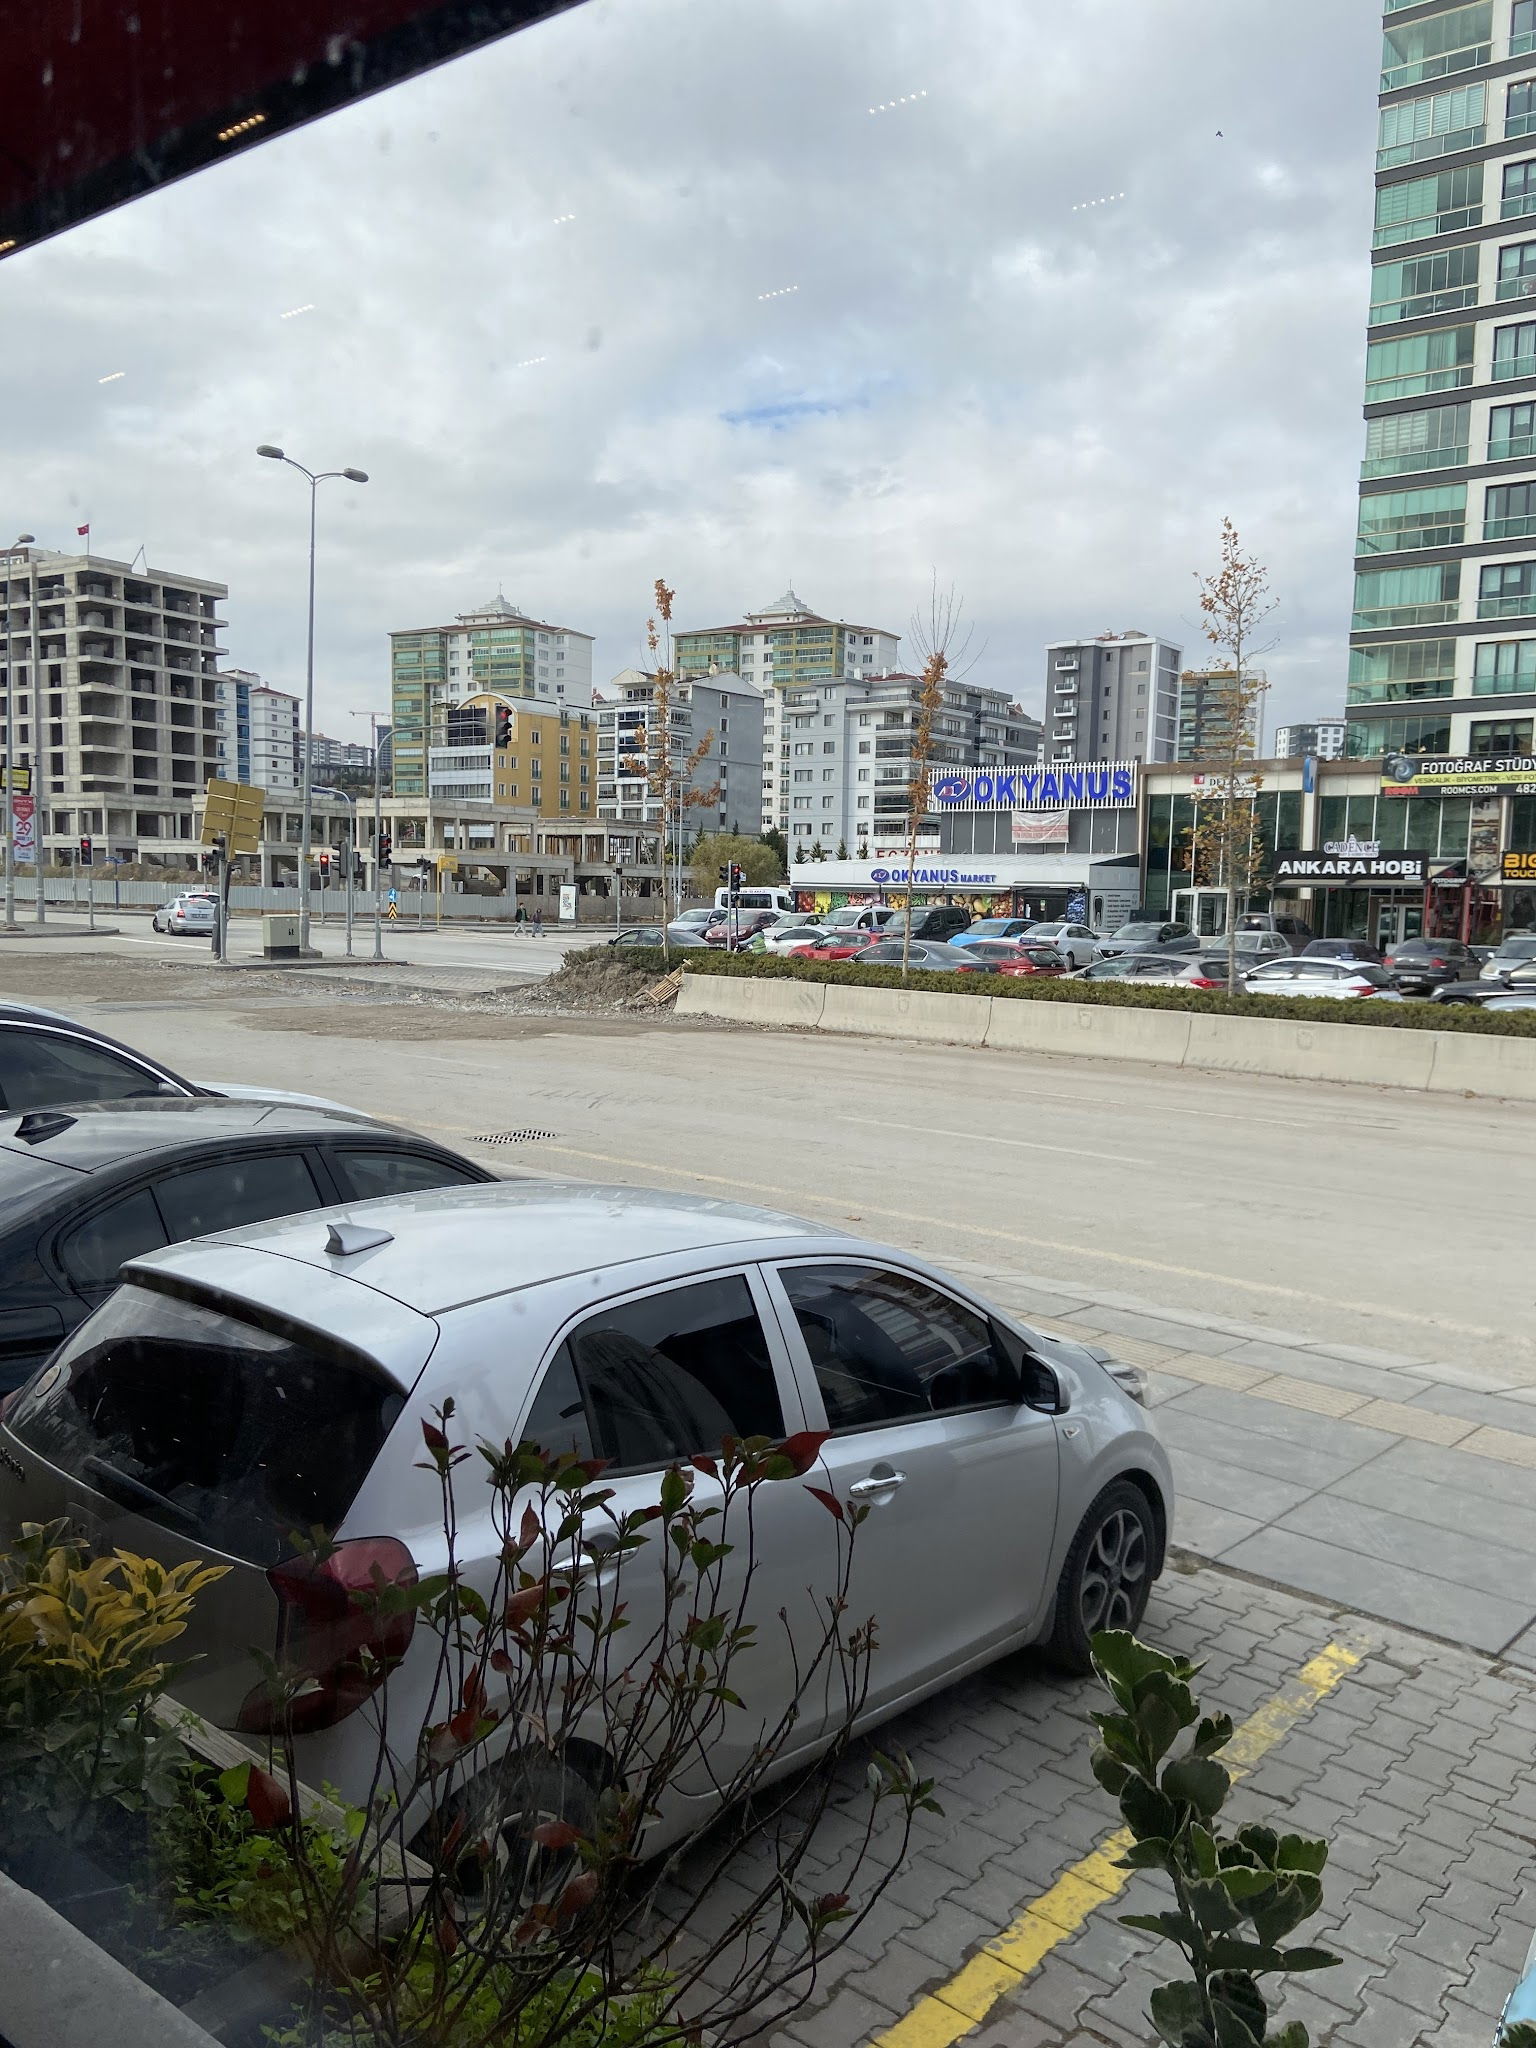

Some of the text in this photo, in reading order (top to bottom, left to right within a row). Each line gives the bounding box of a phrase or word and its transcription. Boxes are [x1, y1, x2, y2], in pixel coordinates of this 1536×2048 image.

[1421, 758, 1492, 774] FOTOĞRAF
[973, 770, 1132, 803] OKYANUS
[1440, 785, 1498, 795] ROOMCS.COM
[15, 821, 32, 836] 29
[1324, 841, 1380, 853] CADENCE
[1278, 861, 1367, 875] ANKARA
[1504, 869, 1536, 878] TOUC
[891, 869, 959, 883] OKYANUS
[960, 874, 997, 883] MARKET
